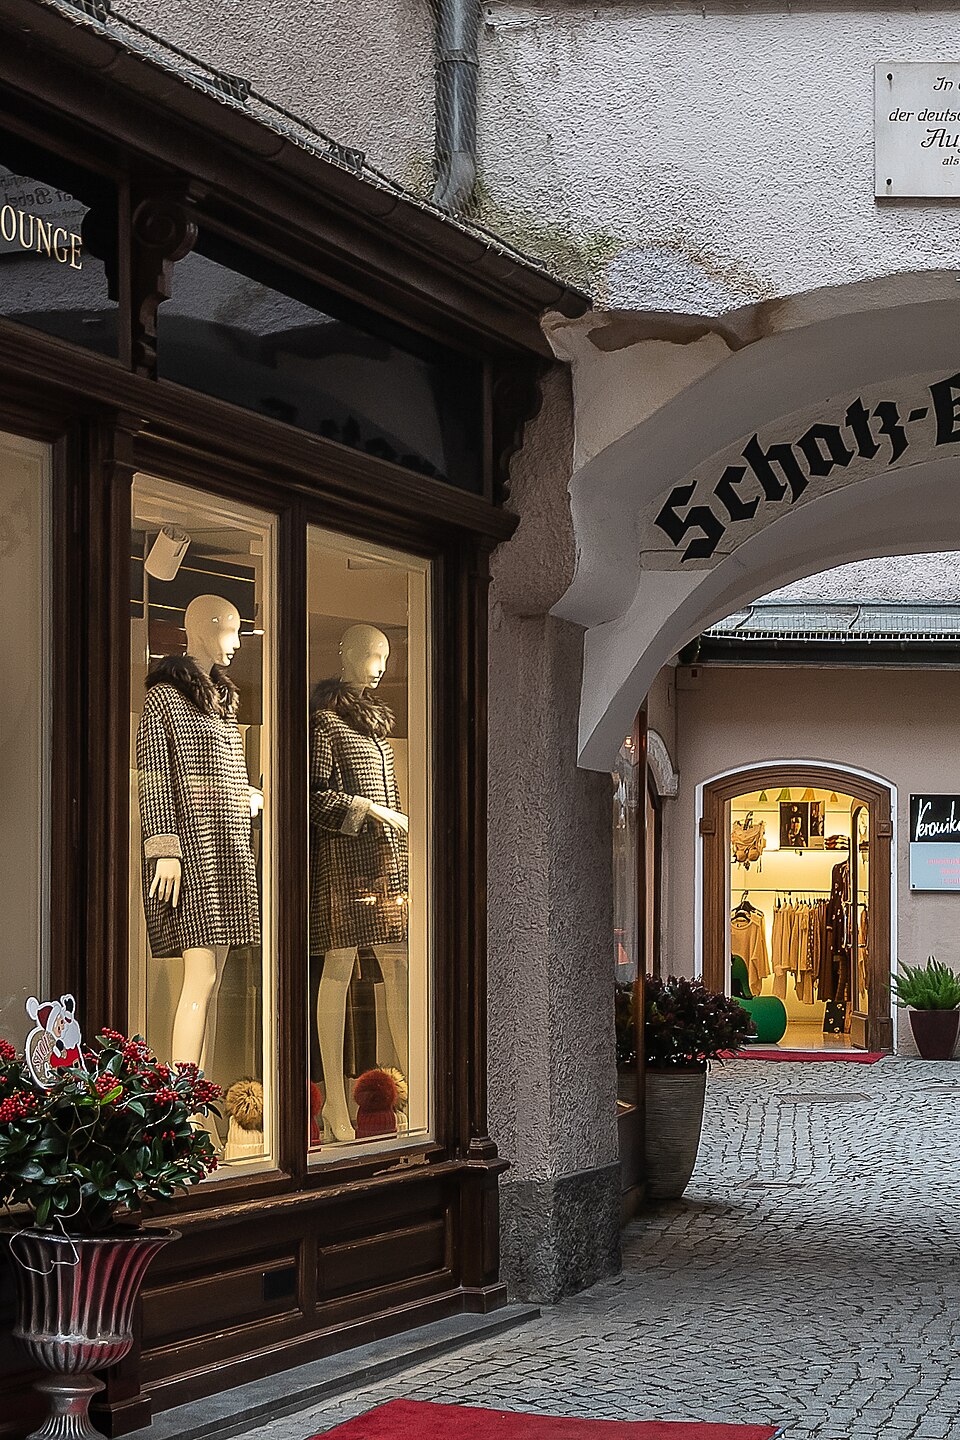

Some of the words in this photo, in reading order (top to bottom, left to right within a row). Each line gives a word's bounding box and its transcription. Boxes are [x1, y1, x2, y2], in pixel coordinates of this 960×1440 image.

[933, 76, 953, 92] In
[888, 109, 914, 123] der
[942, 155, 960, 167] als
[1, 205, 83, 270] OUNGE
